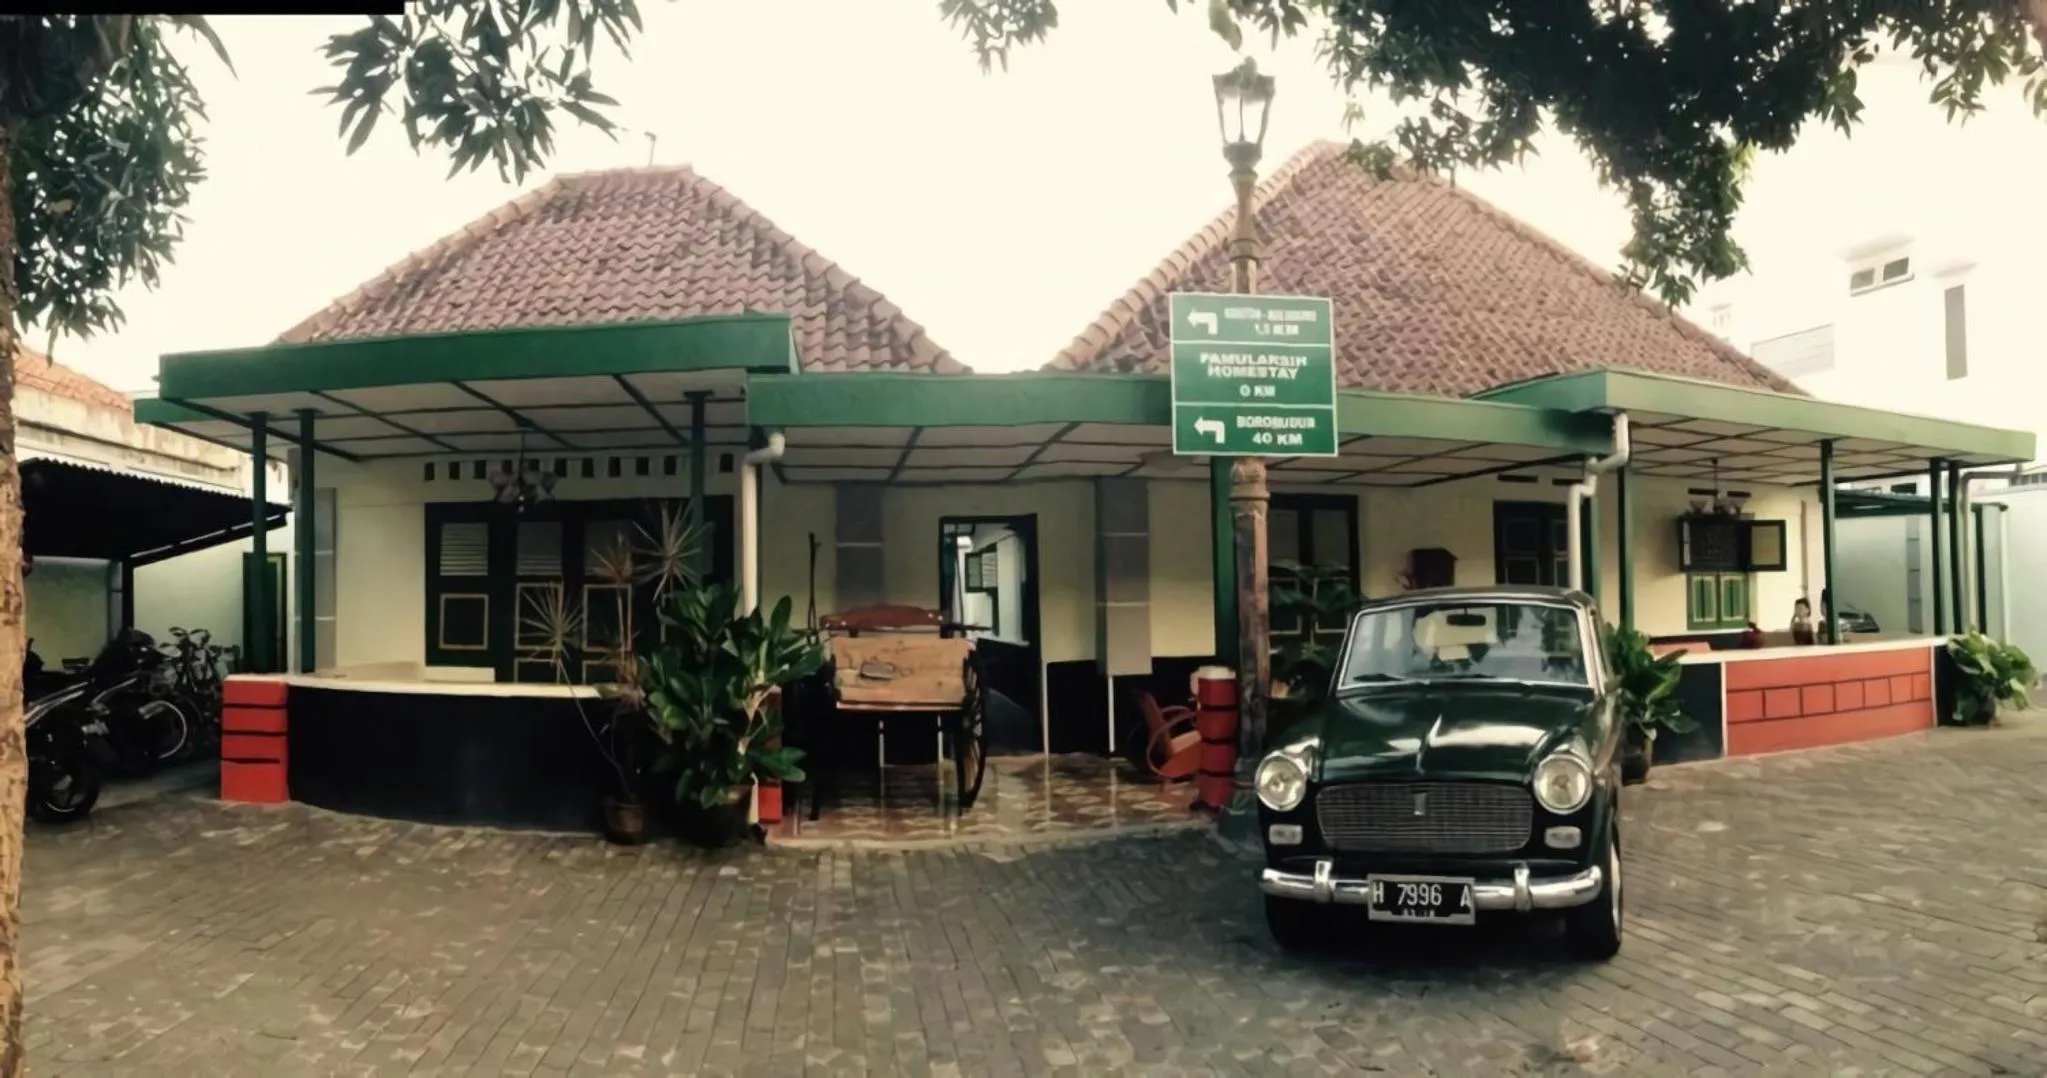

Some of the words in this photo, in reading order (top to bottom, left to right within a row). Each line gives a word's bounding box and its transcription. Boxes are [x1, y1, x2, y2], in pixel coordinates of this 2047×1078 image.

[1207, 366, 1299, 379] HOMESTAY
[1254, 385, 1276, 397] KM
[1236, 416, 1316, 429] BOROBUDUR
[1252, 432, 1272, 445] 40
[1277, 433, 1303, 445] KM
[1373, 881, 1385, 904] H
[1397, 883, 1442, 906] 7996
[1460, 884, 1472, 907] A
